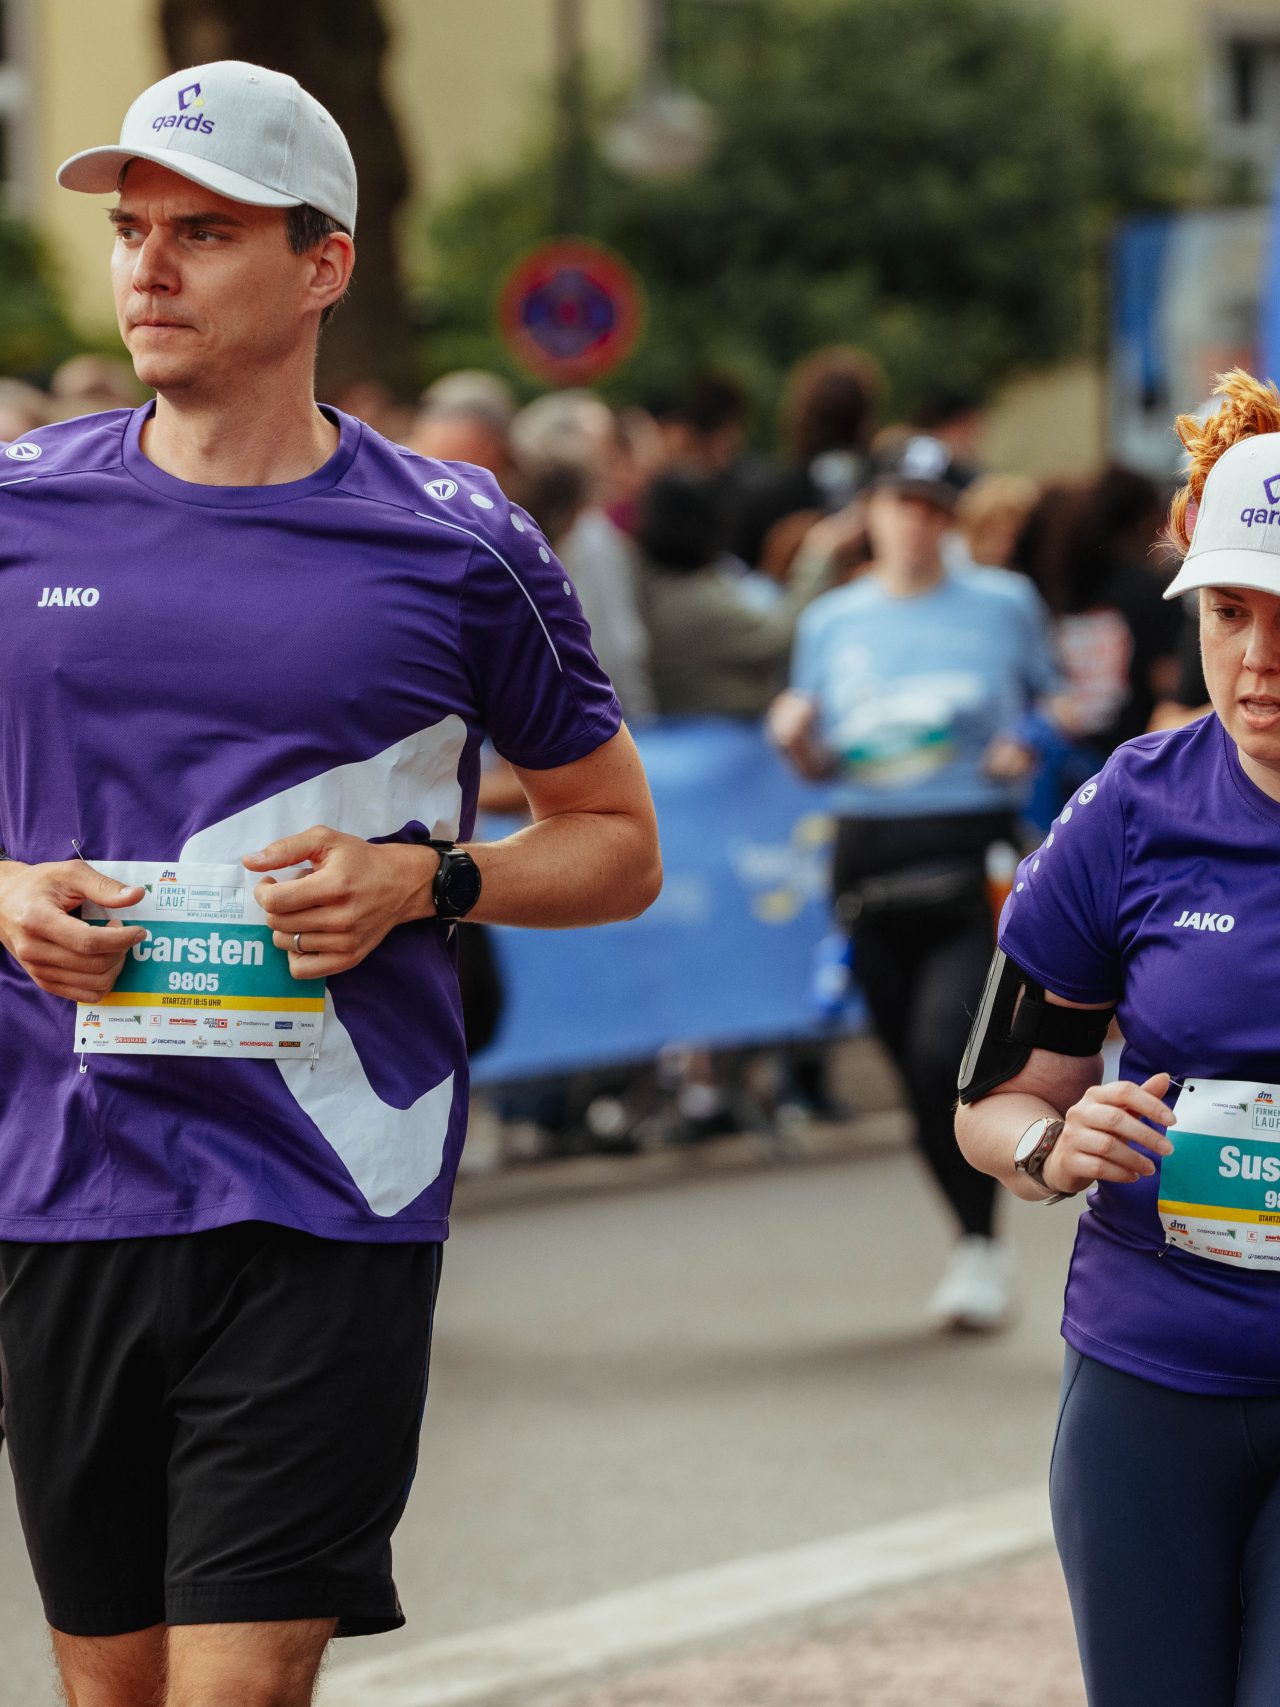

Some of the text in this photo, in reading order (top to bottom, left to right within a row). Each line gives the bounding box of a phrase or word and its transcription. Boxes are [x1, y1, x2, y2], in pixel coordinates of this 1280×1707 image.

[152, 113, 216, 135] qards
[37, 587, 100, 607] JAKO
[160, 887, 186, 896] FIRMEN
[159, 896, 186, 908] LAUF
[1173, 910, 1235, 933] JAKO
[132, 929, 264, 966] Carsten
[168, 972, 219, 992] 9805
[162, 997, 192, 1005] STARTZEIT
[209, 999, 222, 1007] UHR
[1257, 1090, 1272, 1100] dm
[1255, 1118, 1280, 1129] LAUF
